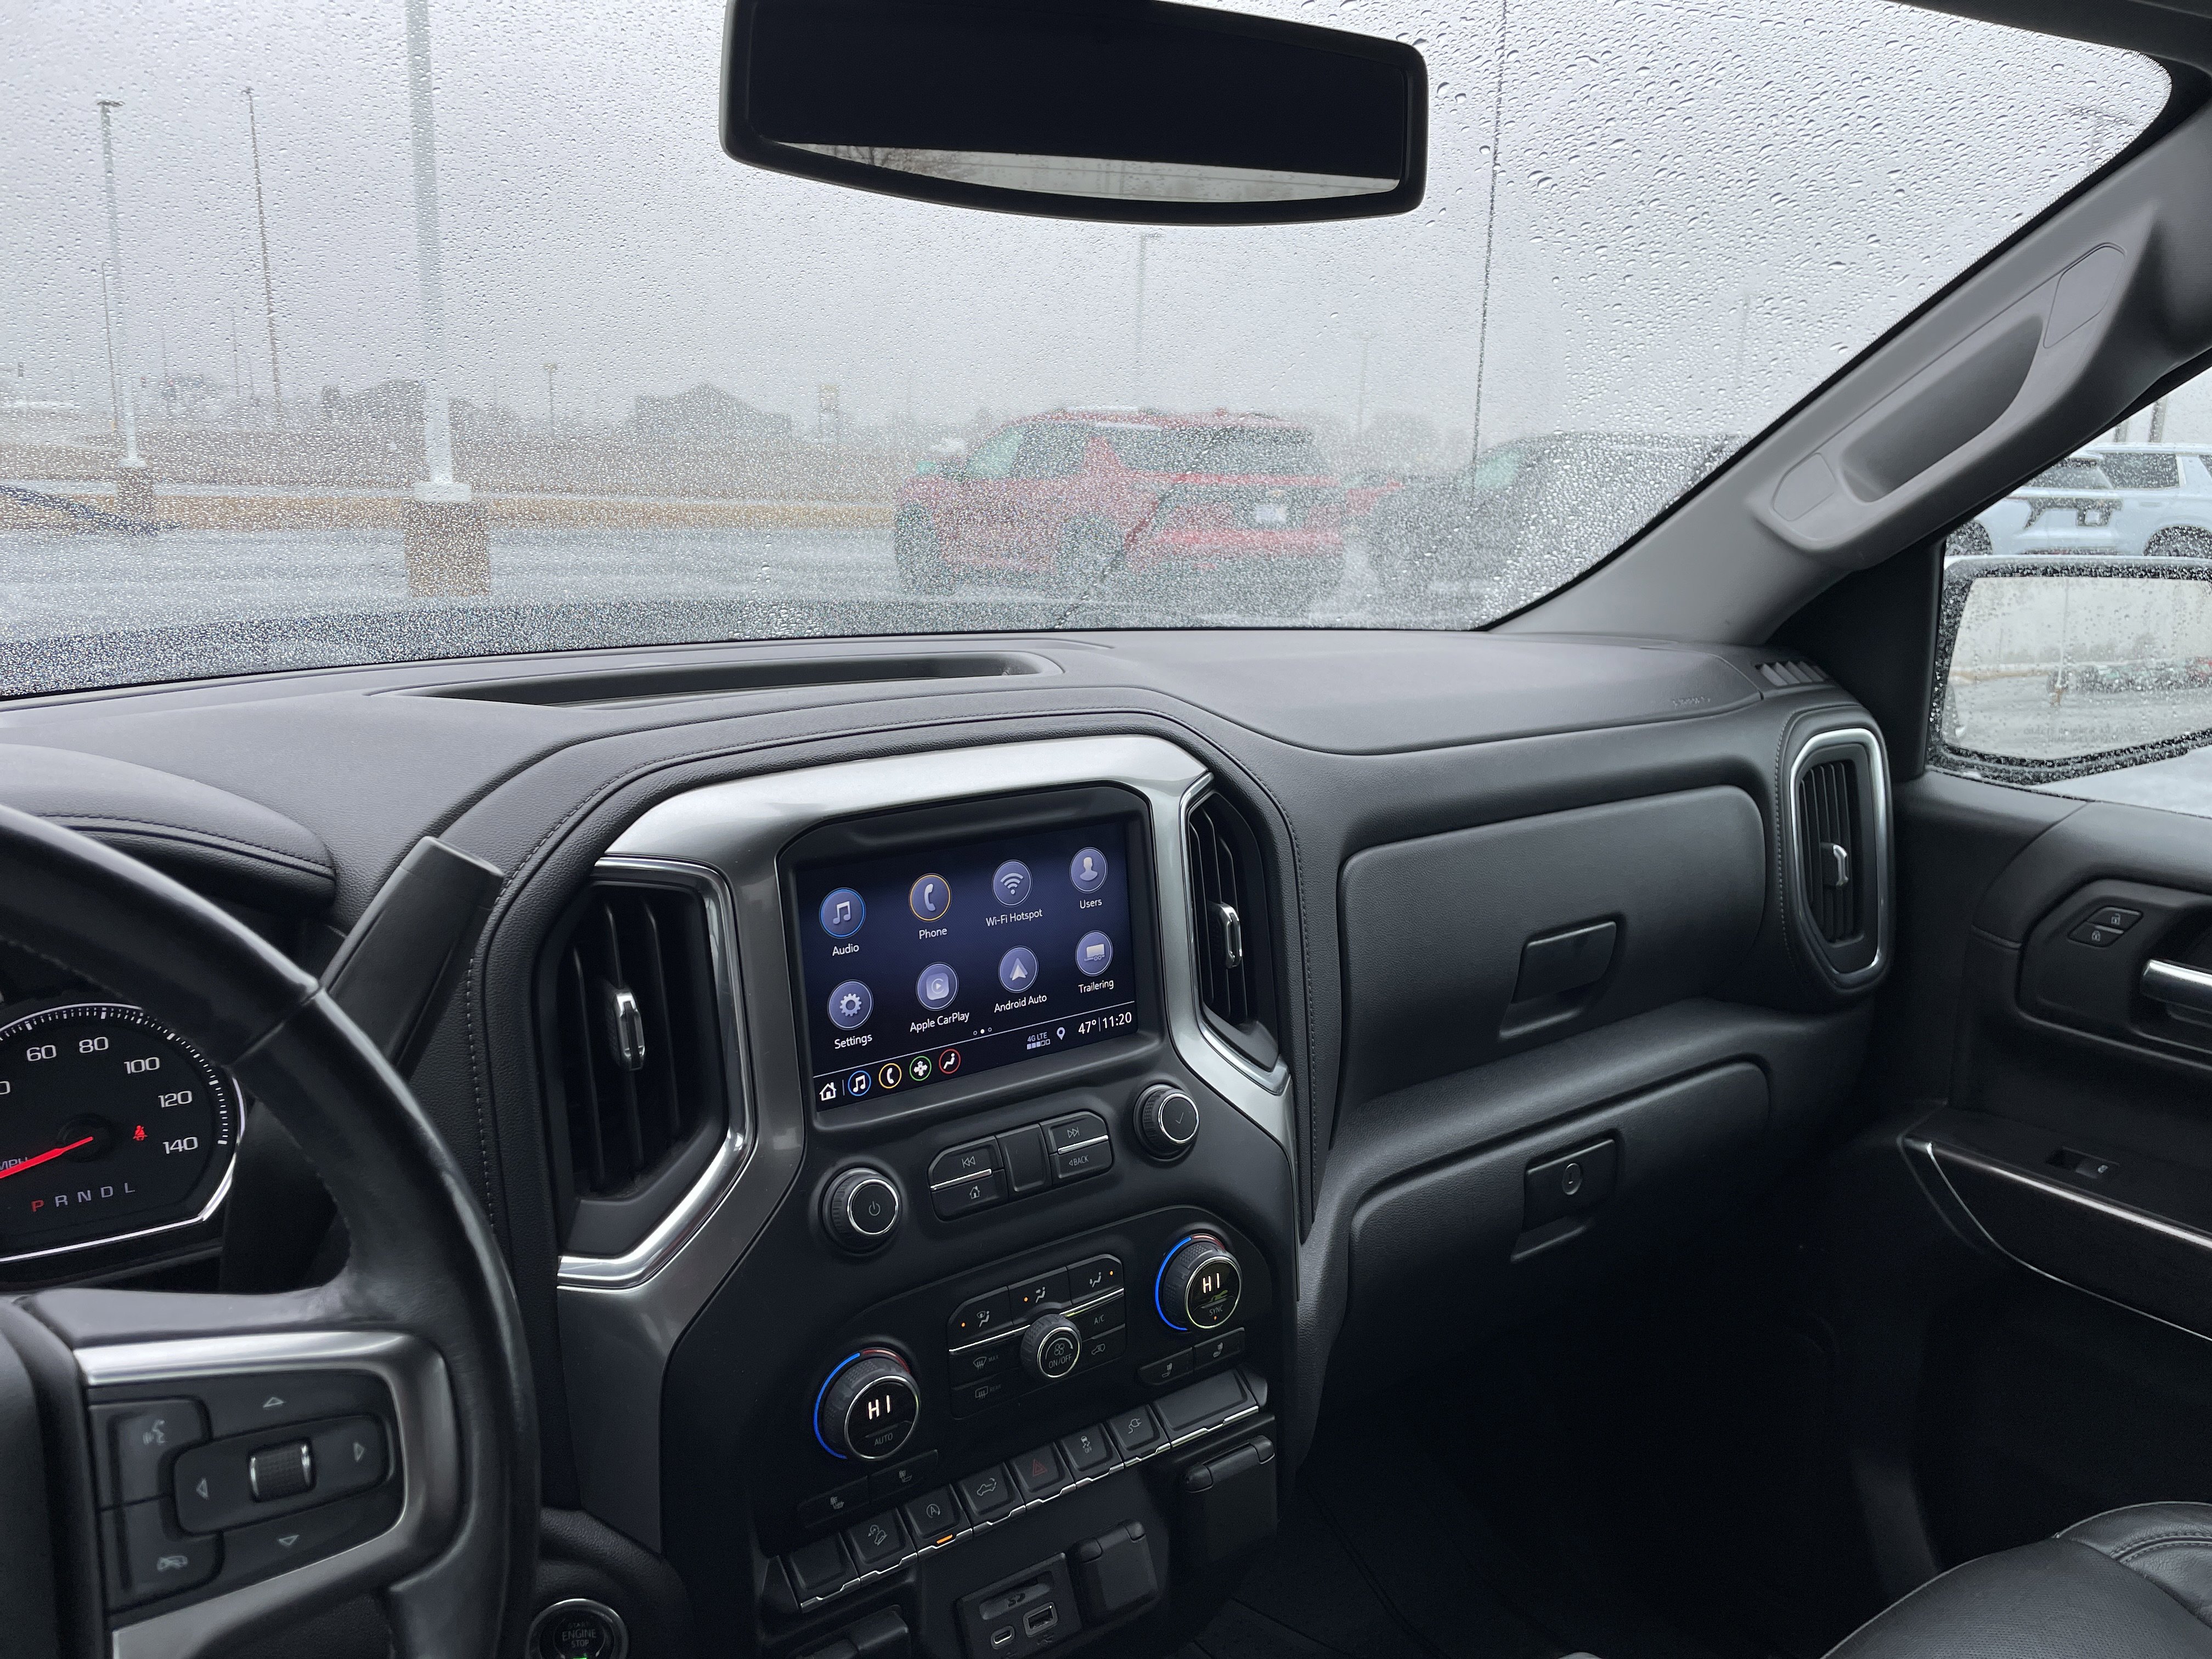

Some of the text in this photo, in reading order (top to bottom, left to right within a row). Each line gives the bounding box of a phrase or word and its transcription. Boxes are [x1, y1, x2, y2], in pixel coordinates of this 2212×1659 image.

[1079, 898, 1103, 909] Users
[985, 909, 1043, 927] Wi-Fi Hotspot
[918, 928, 947, 940] Phone
[832, 943, 860, 956] Audio
[1078, 979, 1114, 994] Trailering
[994, 994, 1047, 1013] Android Auto
[910, 1012, 970, 1034] Apple CarPlay
[1102, 1012, 1132, 1029] 11:20
[834, 1034, 873, 1049] Settings
[1036, 1031, 1048, 1041] LTE
[78, 1036, 109, 1053] 80
[26, 1045, 57, 1062] 60
[123, 1057, 160, 1074] 100
[157, 1090, 193, 1108] 120
[162, 1136, 199, 1154] 140
[1073, 1154, 1089, 1166] BACK
[31, 1182, 136, 1212] P R N D L
[1203, 1273, 1220, 1294] HI
[1209, 1304, 1223, 1317] SYNC
[1093, 1314, 1105, 1325] A/C
[1048, 1353, 1073, 1369] ON/OFF
[868, 1395, 890, 1420] HI
[874, 1432, 893, 1447] AUTO
[562, 1628, 597, 1642] ENGINE
[571, 1639, 590, 1649] STOP
